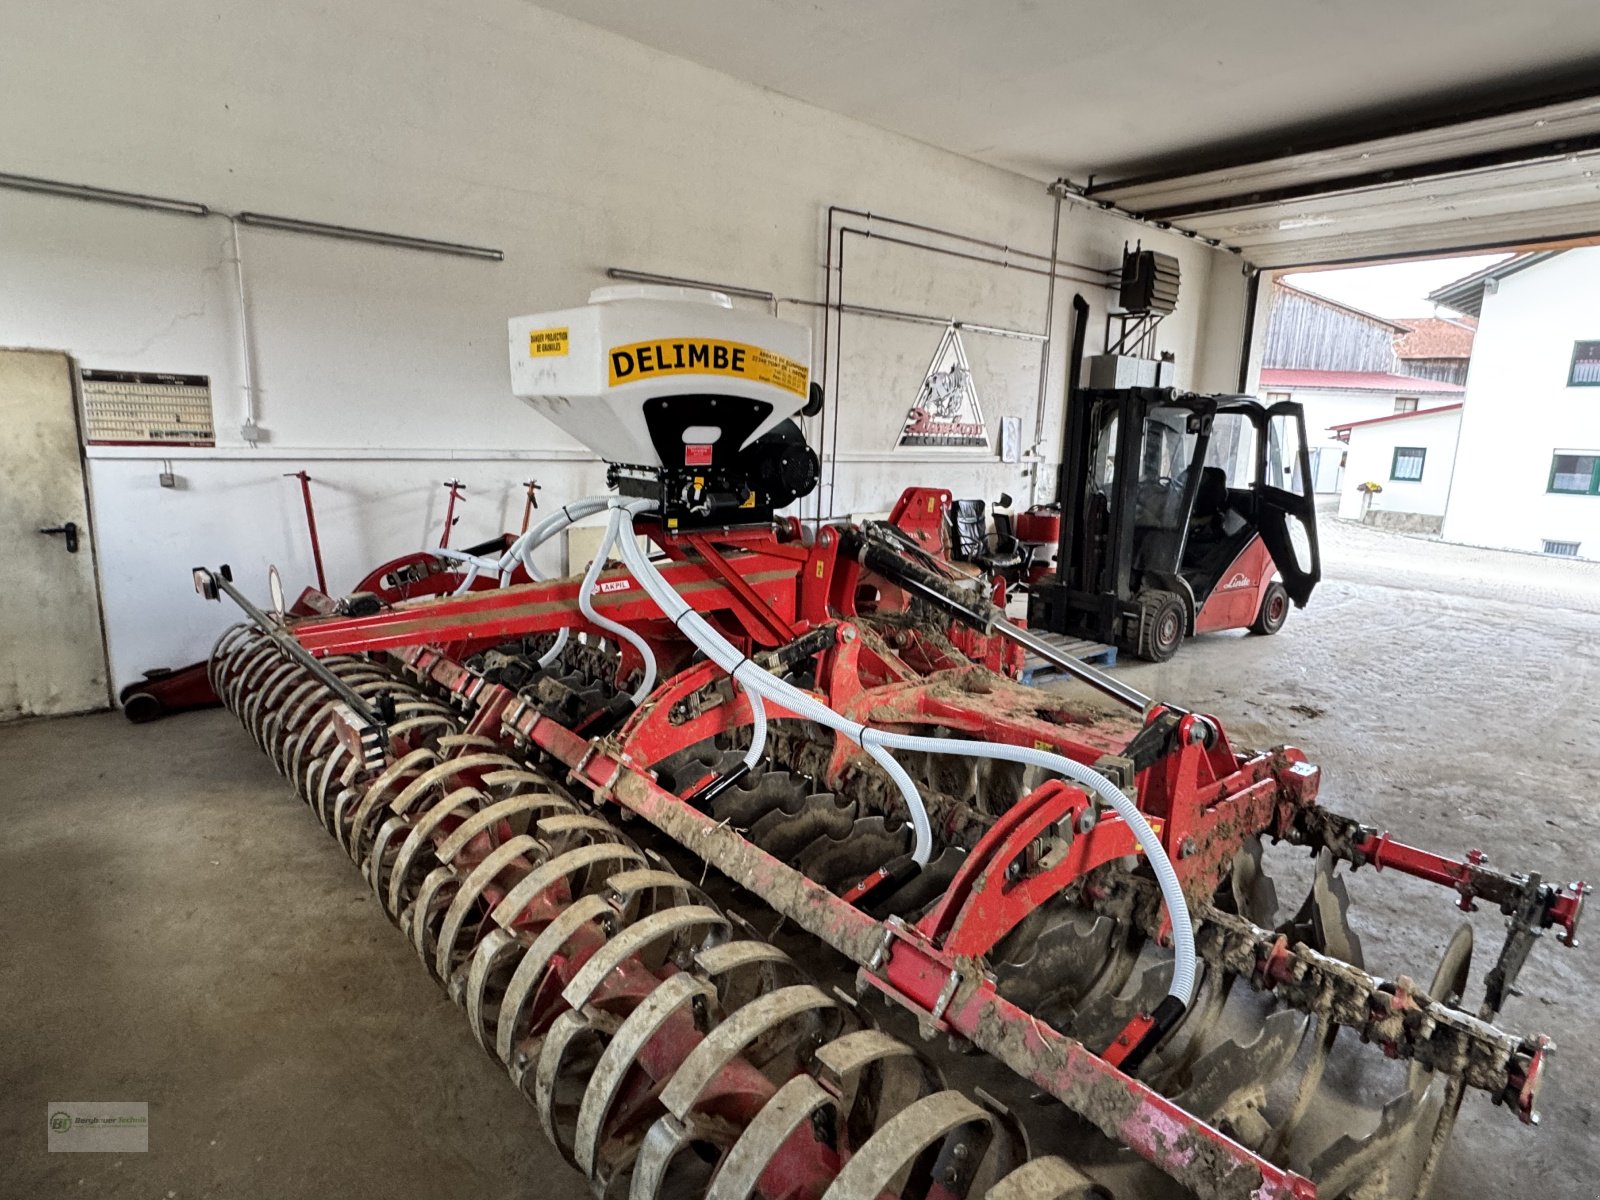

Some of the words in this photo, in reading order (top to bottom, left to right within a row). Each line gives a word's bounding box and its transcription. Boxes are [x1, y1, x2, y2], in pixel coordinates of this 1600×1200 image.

[612, 343, 746, 378] DELIMBE
[604, 582, 627, 590] AKPIL
[1223, 572, 1250, 589] Linde
